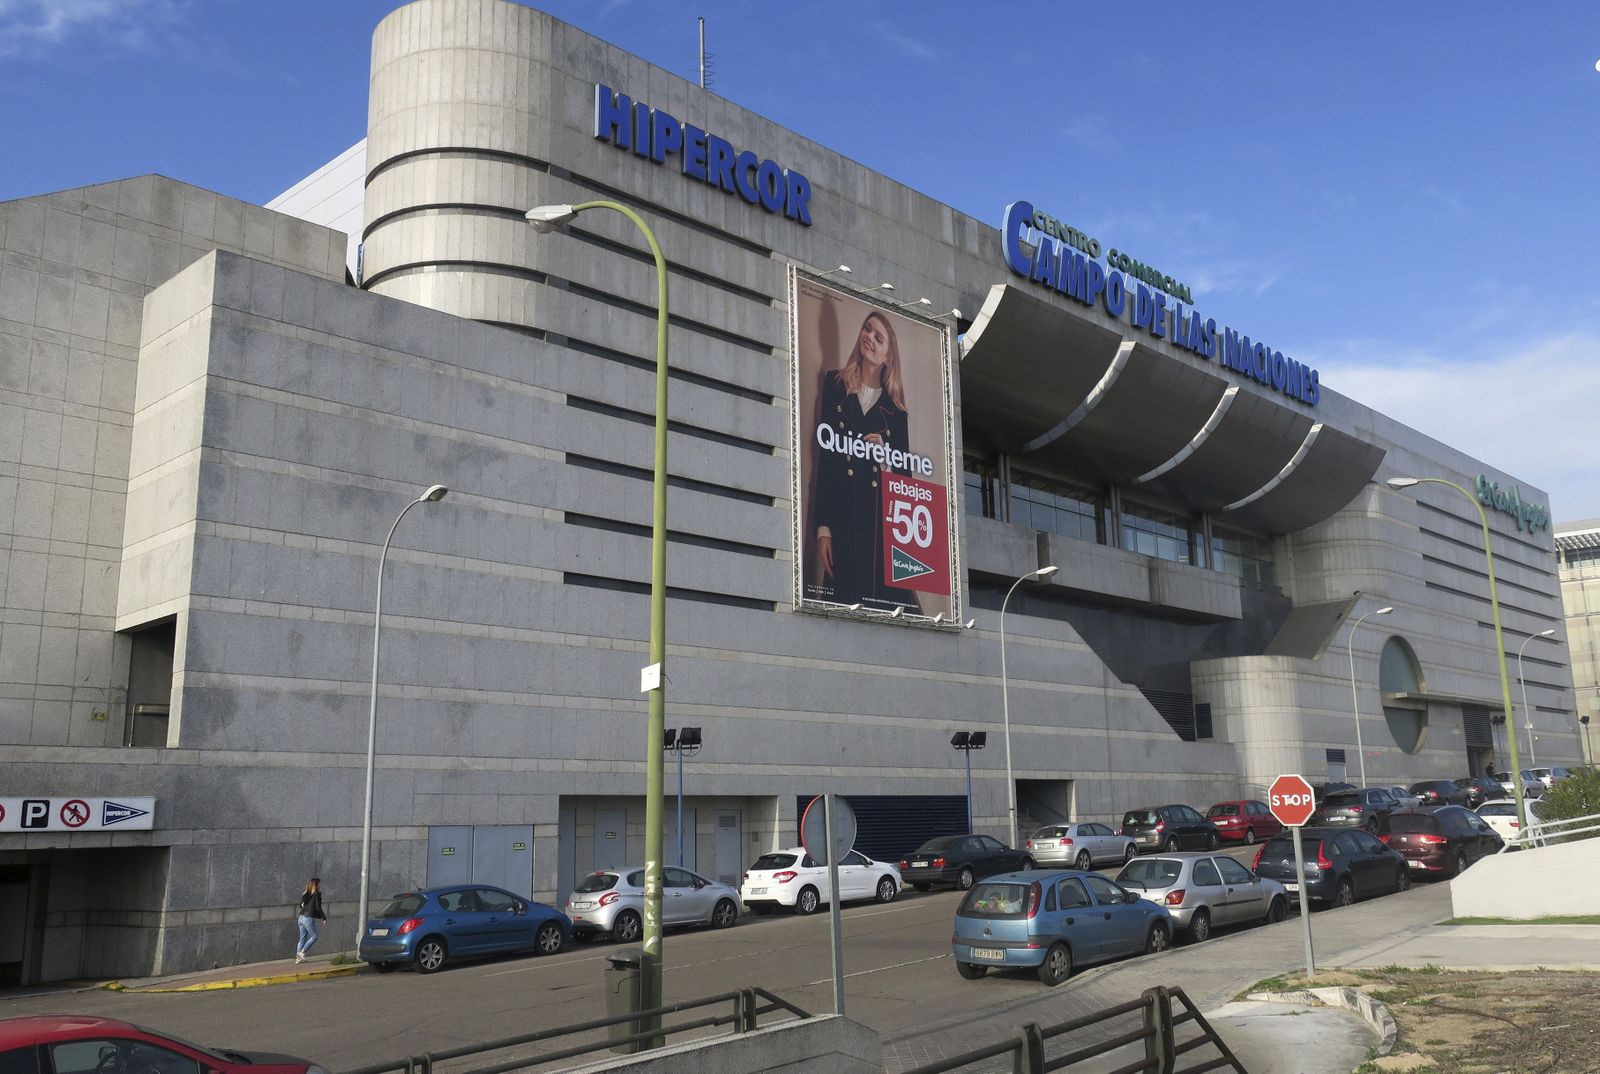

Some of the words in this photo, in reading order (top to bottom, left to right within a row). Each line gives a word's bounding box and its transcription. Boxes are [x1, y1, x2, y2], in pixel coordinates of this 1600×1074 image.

[595, 83, 812, 226] HIPERCOR
[1032, 209, 1102, 258] CENTRO
[1107, 247, 1195, 306] COMERCIAL
[1002, 200, 1126, 318] CAMPO
[1132, 283, 1166, 338] DE
[1171, 300, 1217, 360] LAS
[1221, 326, 1320, 407] NACIONES
[816, 422, 934, 477] Quiéreteme
[888, 480, 933, 501] rebajas
[25, 802, 47, 826] P
[1272, 794, 1311, 806] STOP
